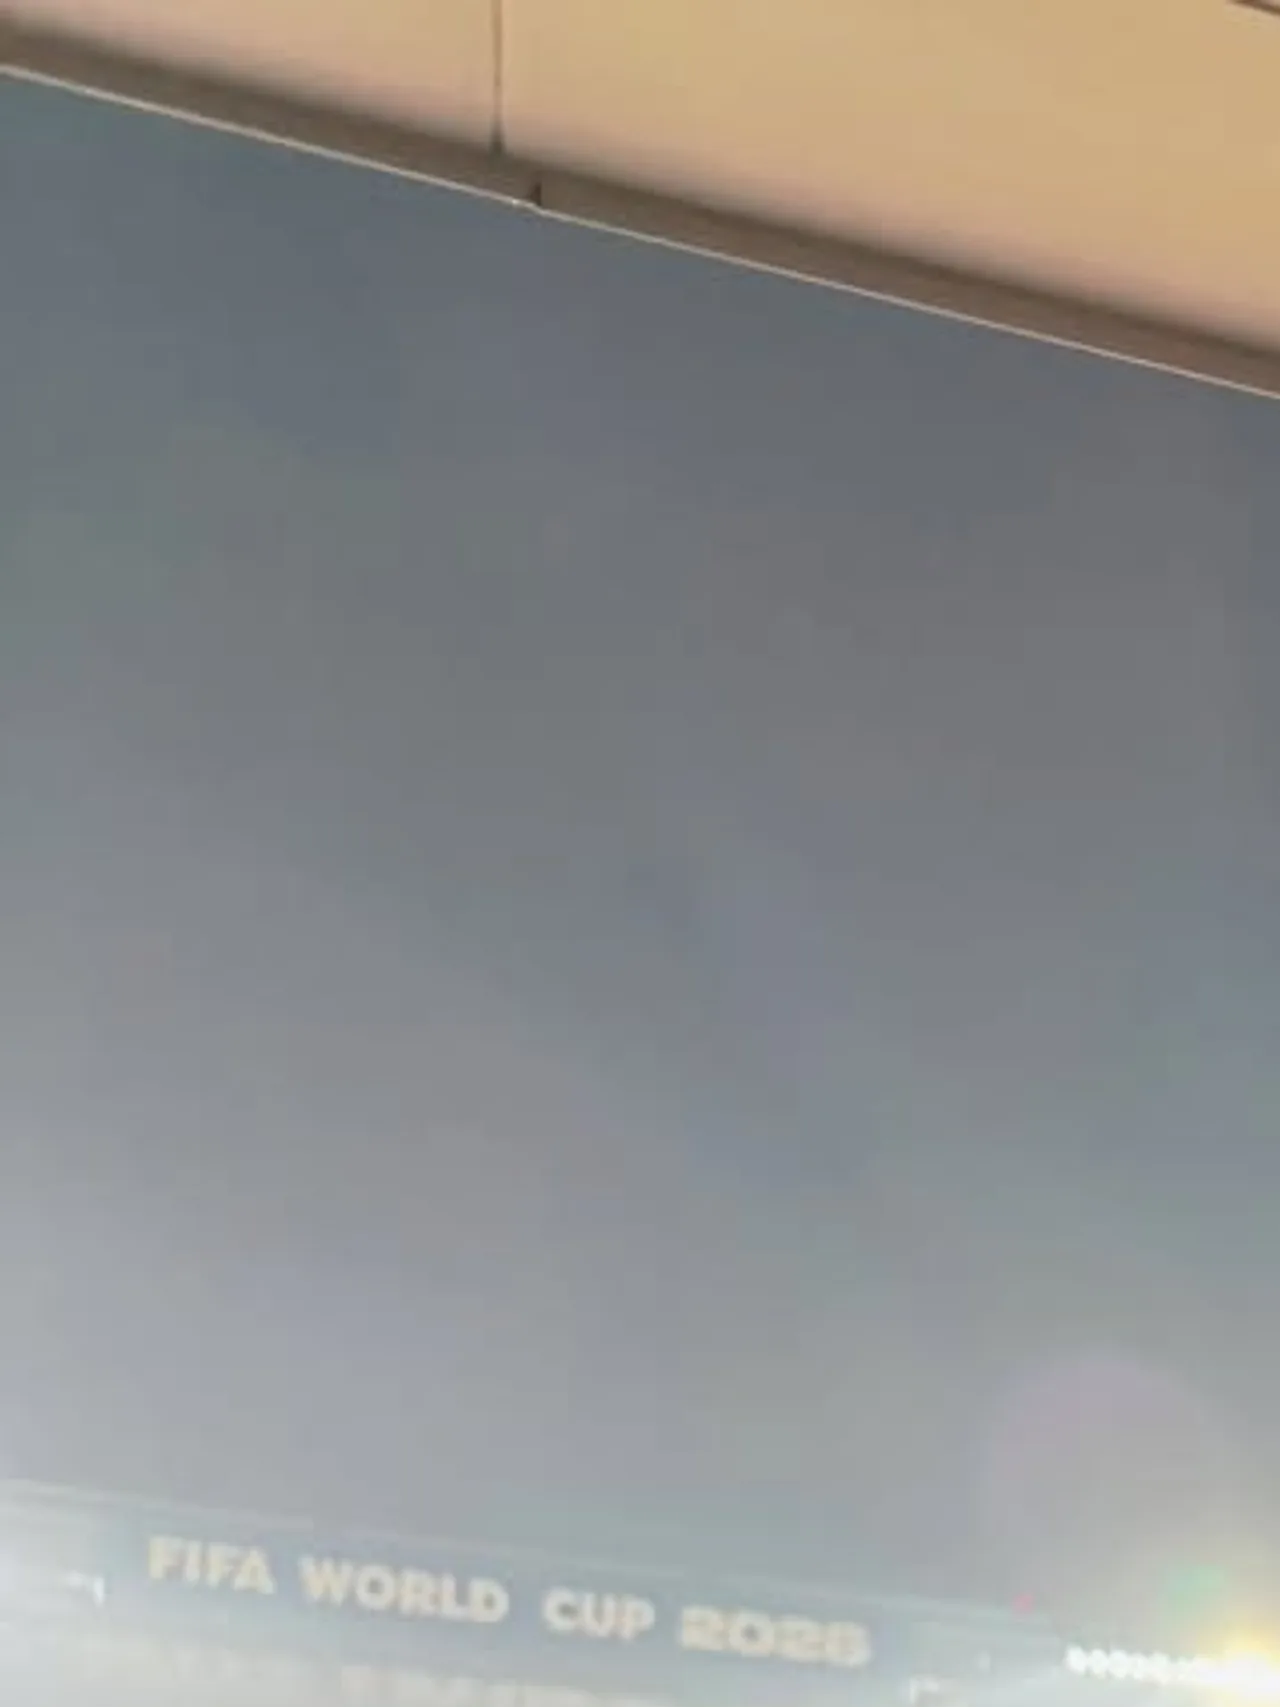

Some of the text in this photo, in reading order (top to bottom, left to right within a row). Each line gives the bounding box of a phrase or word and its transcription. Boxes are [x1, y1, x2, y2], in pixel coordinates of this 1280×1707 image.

[148, 1535, 276, 1595] FIFA
[298, 1555, 510, 1624] WORLD
[545, 1587, 656, 1641] CUP
